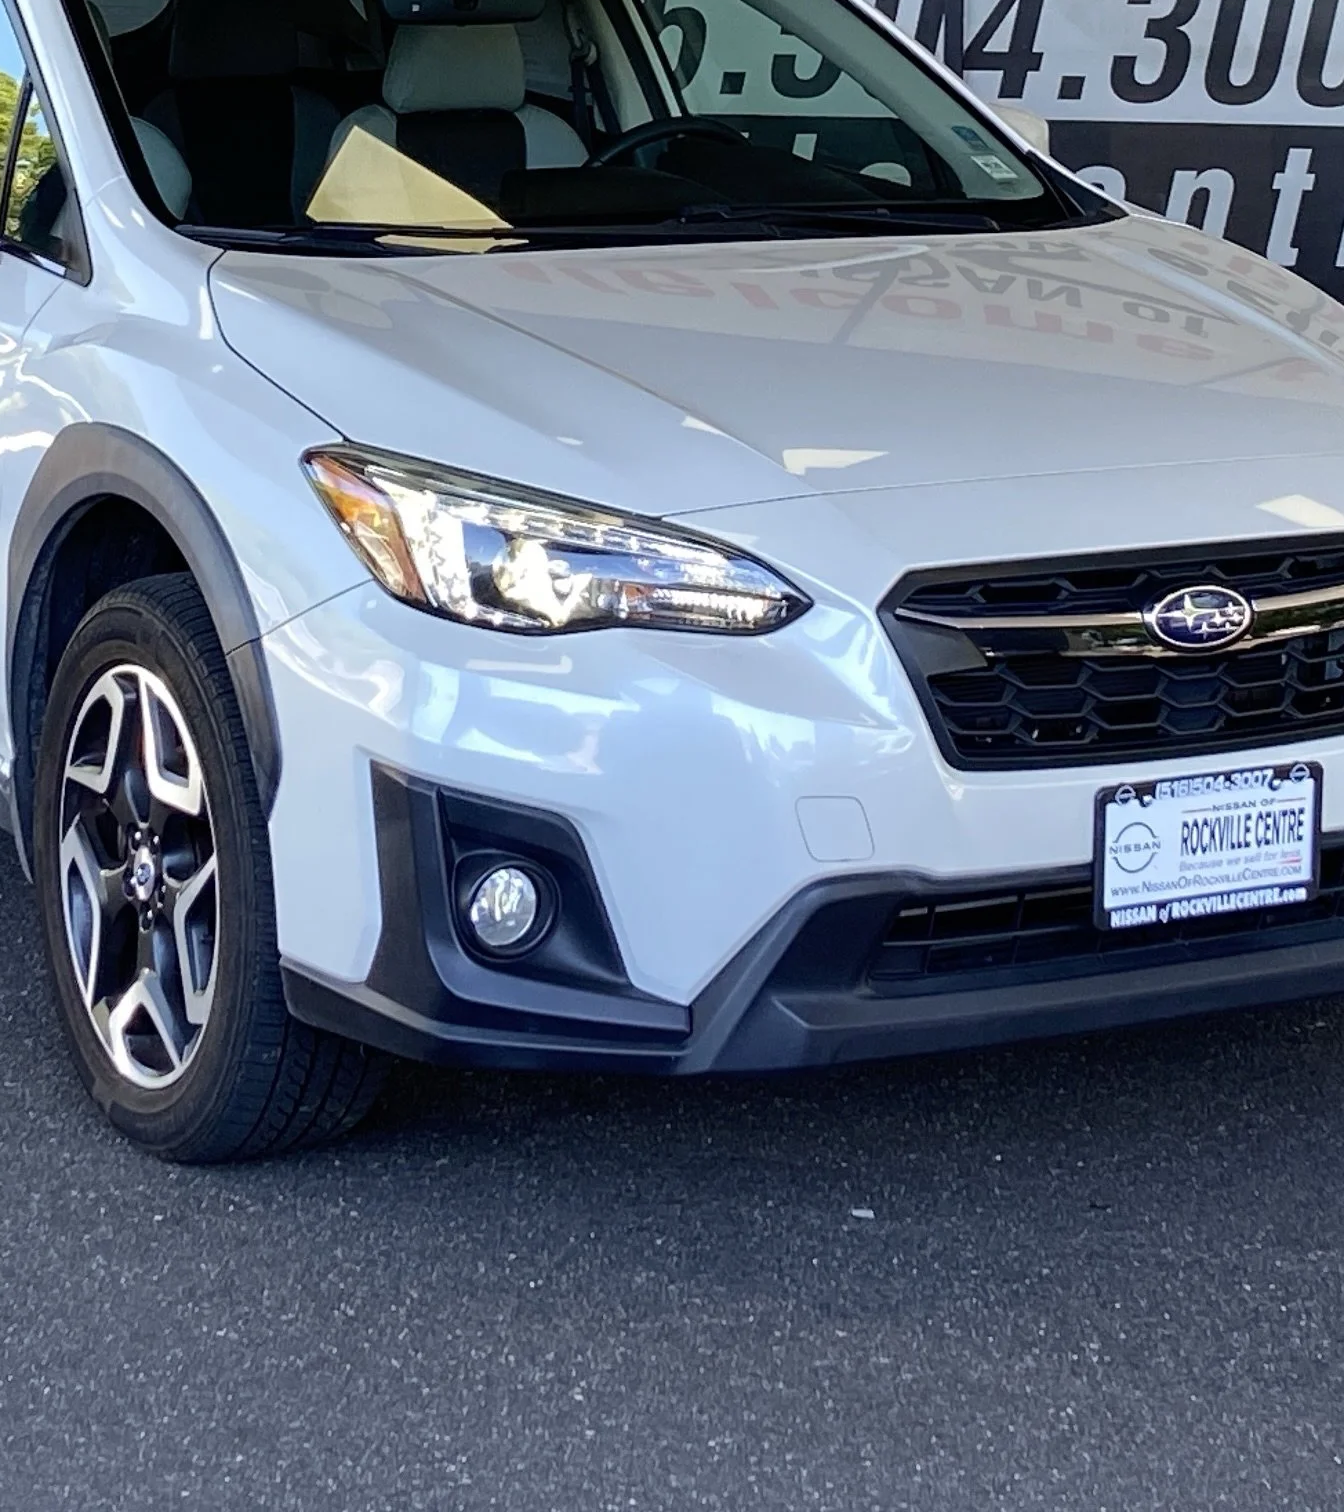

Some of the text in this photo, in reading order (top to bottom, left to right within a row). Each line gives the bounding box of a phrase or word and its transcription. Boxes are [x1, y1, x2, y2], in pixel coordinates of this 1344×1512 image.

[1212, 798, 1276, 812] NISSAN OF
[1180, 807, 1305, 857] ROCKVILLE CENTRE
[1109, 841, 1161, 855] NISSAN
[1110, 904, 1156, 928] NISSAN
